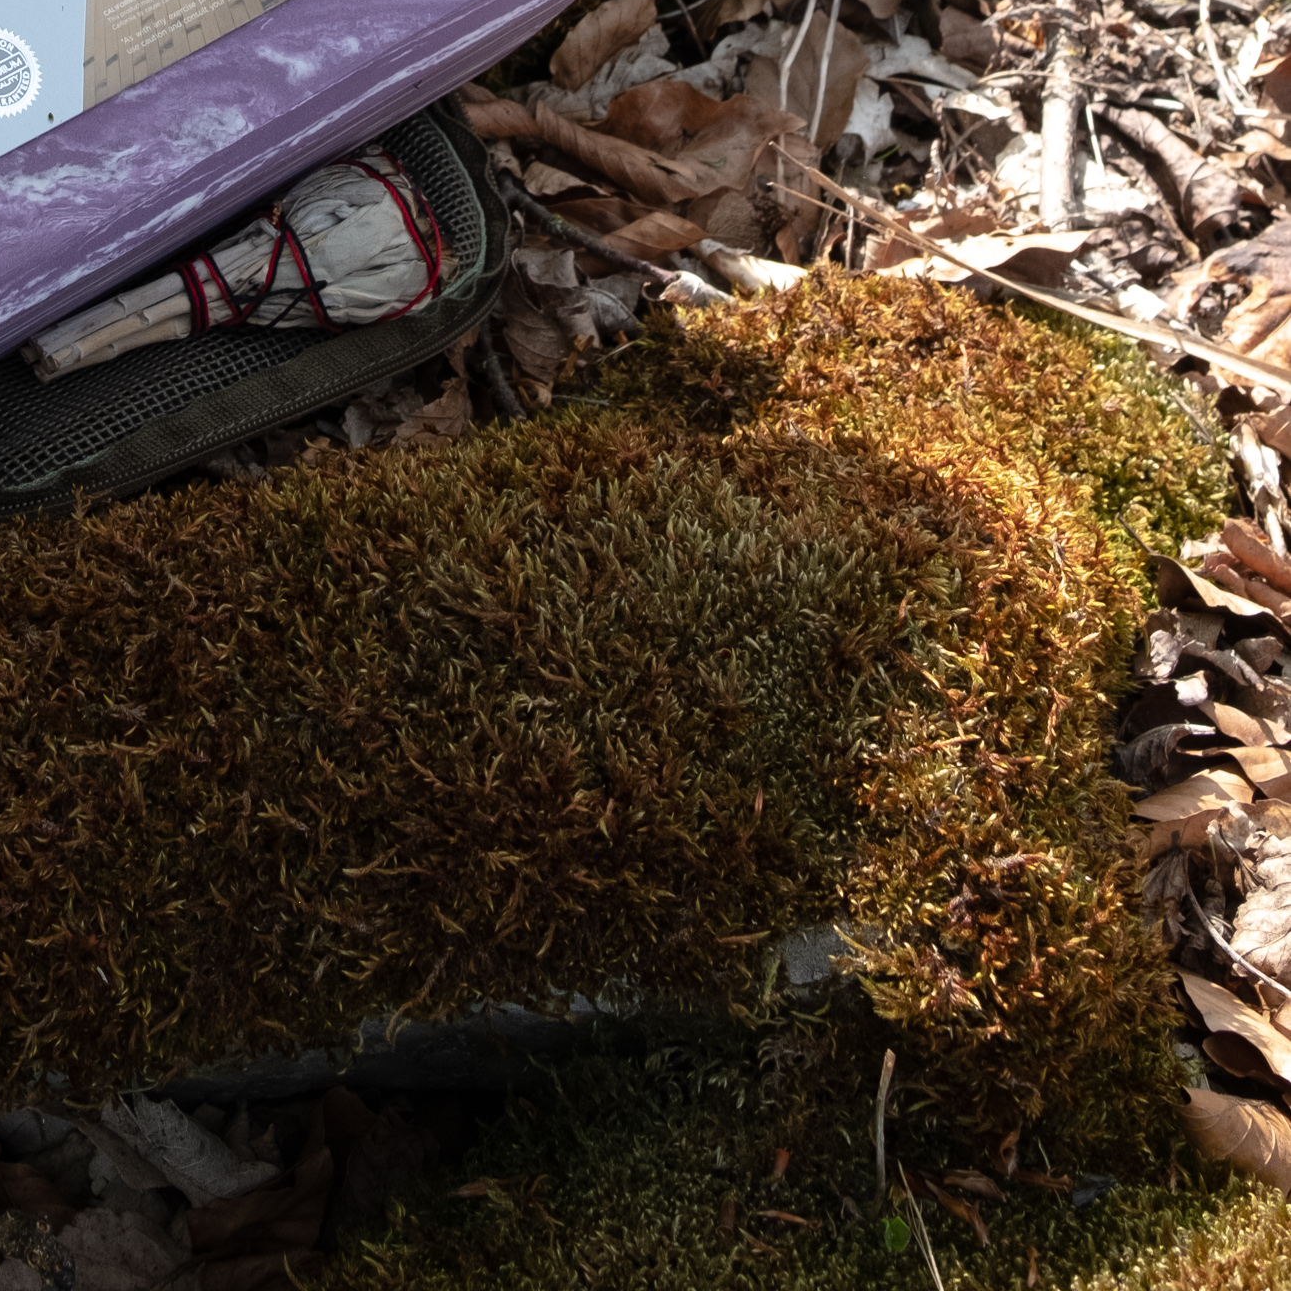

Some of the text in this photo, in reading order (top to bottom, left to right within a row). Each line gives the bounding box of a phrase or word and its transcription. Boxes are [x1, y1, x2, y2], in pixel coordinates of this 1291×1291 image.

[126, 43, 140, 55] use
[139, 28, 167, 47] caution
[166, 19, 182, 32] and
[182, 5, 208, 24] consult
[134, 24, 151, 38] with
[152, 17, 167, 30] any
[167, 0, 196, 20] exercise
